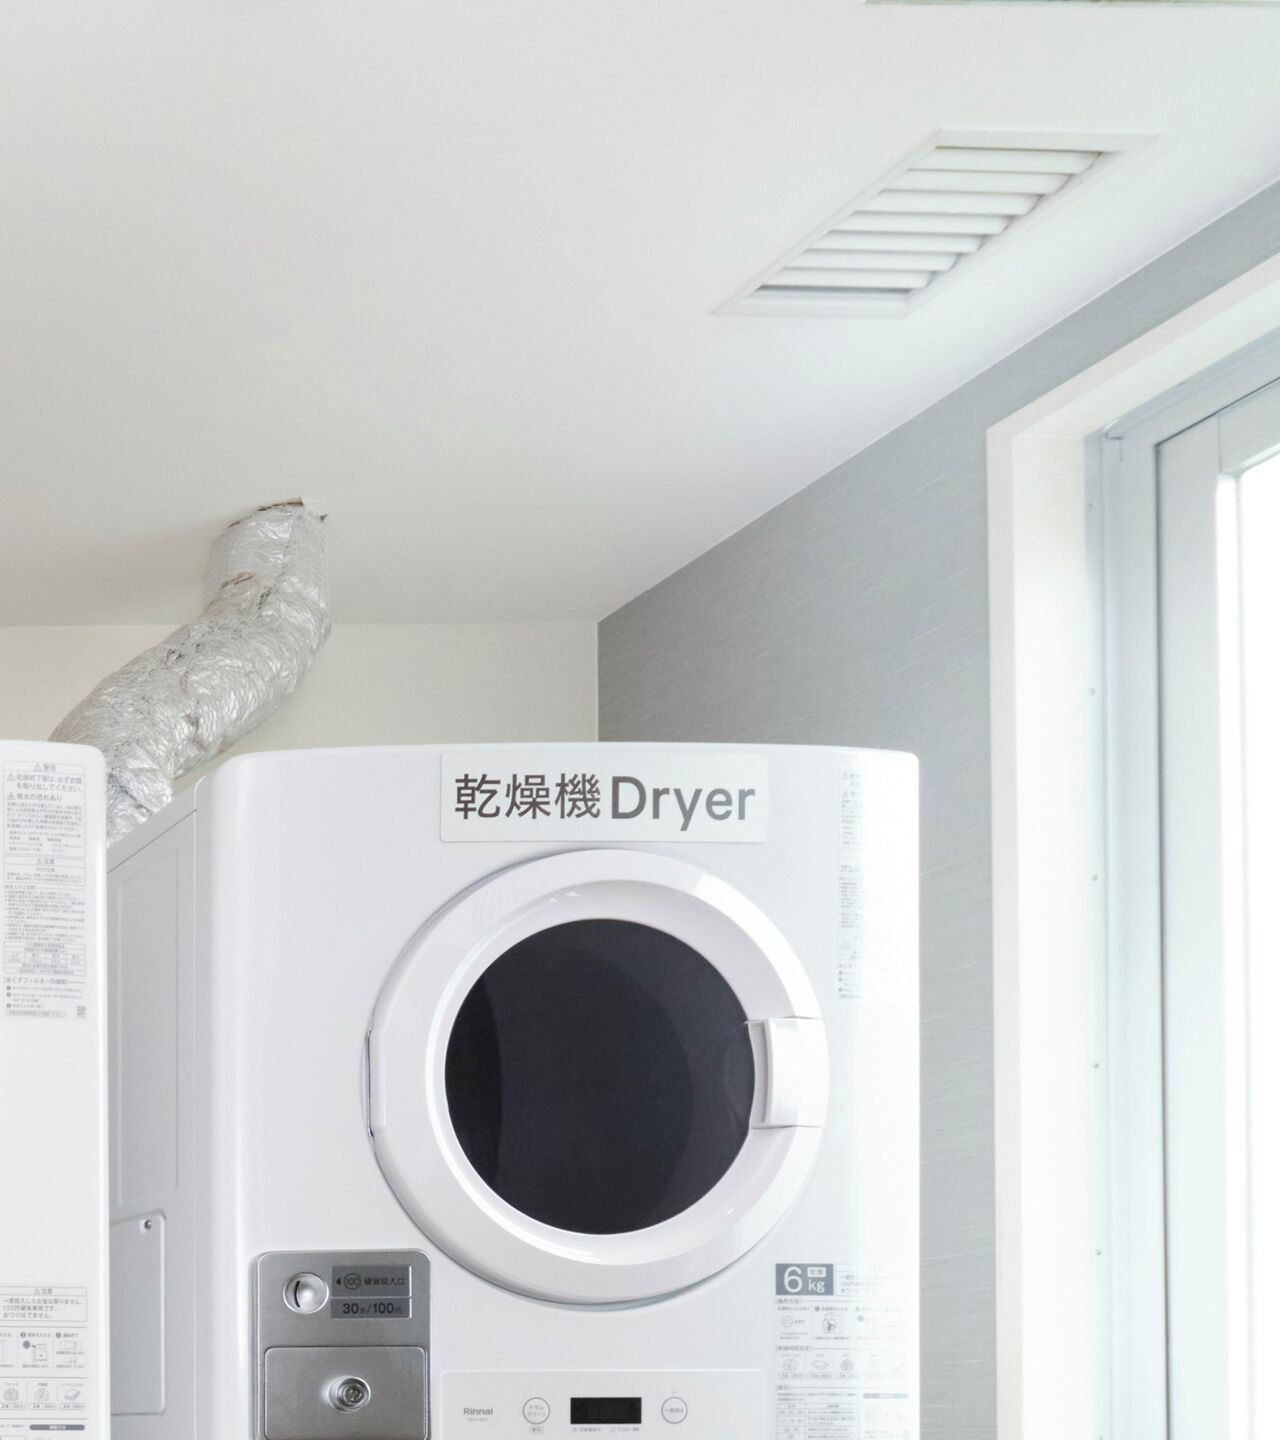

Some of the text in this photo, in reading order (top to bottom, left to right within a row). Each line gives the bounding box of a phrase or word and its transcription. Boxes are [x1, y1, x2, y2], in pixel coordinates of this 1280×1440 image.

[455, 773, 756, 832] 乾燥機 Dryer
[784, 1266, 803, 1293] 6
[808, 1279, 826, 1293] kg
[463, 1407, 493, 1416] Rinnai
